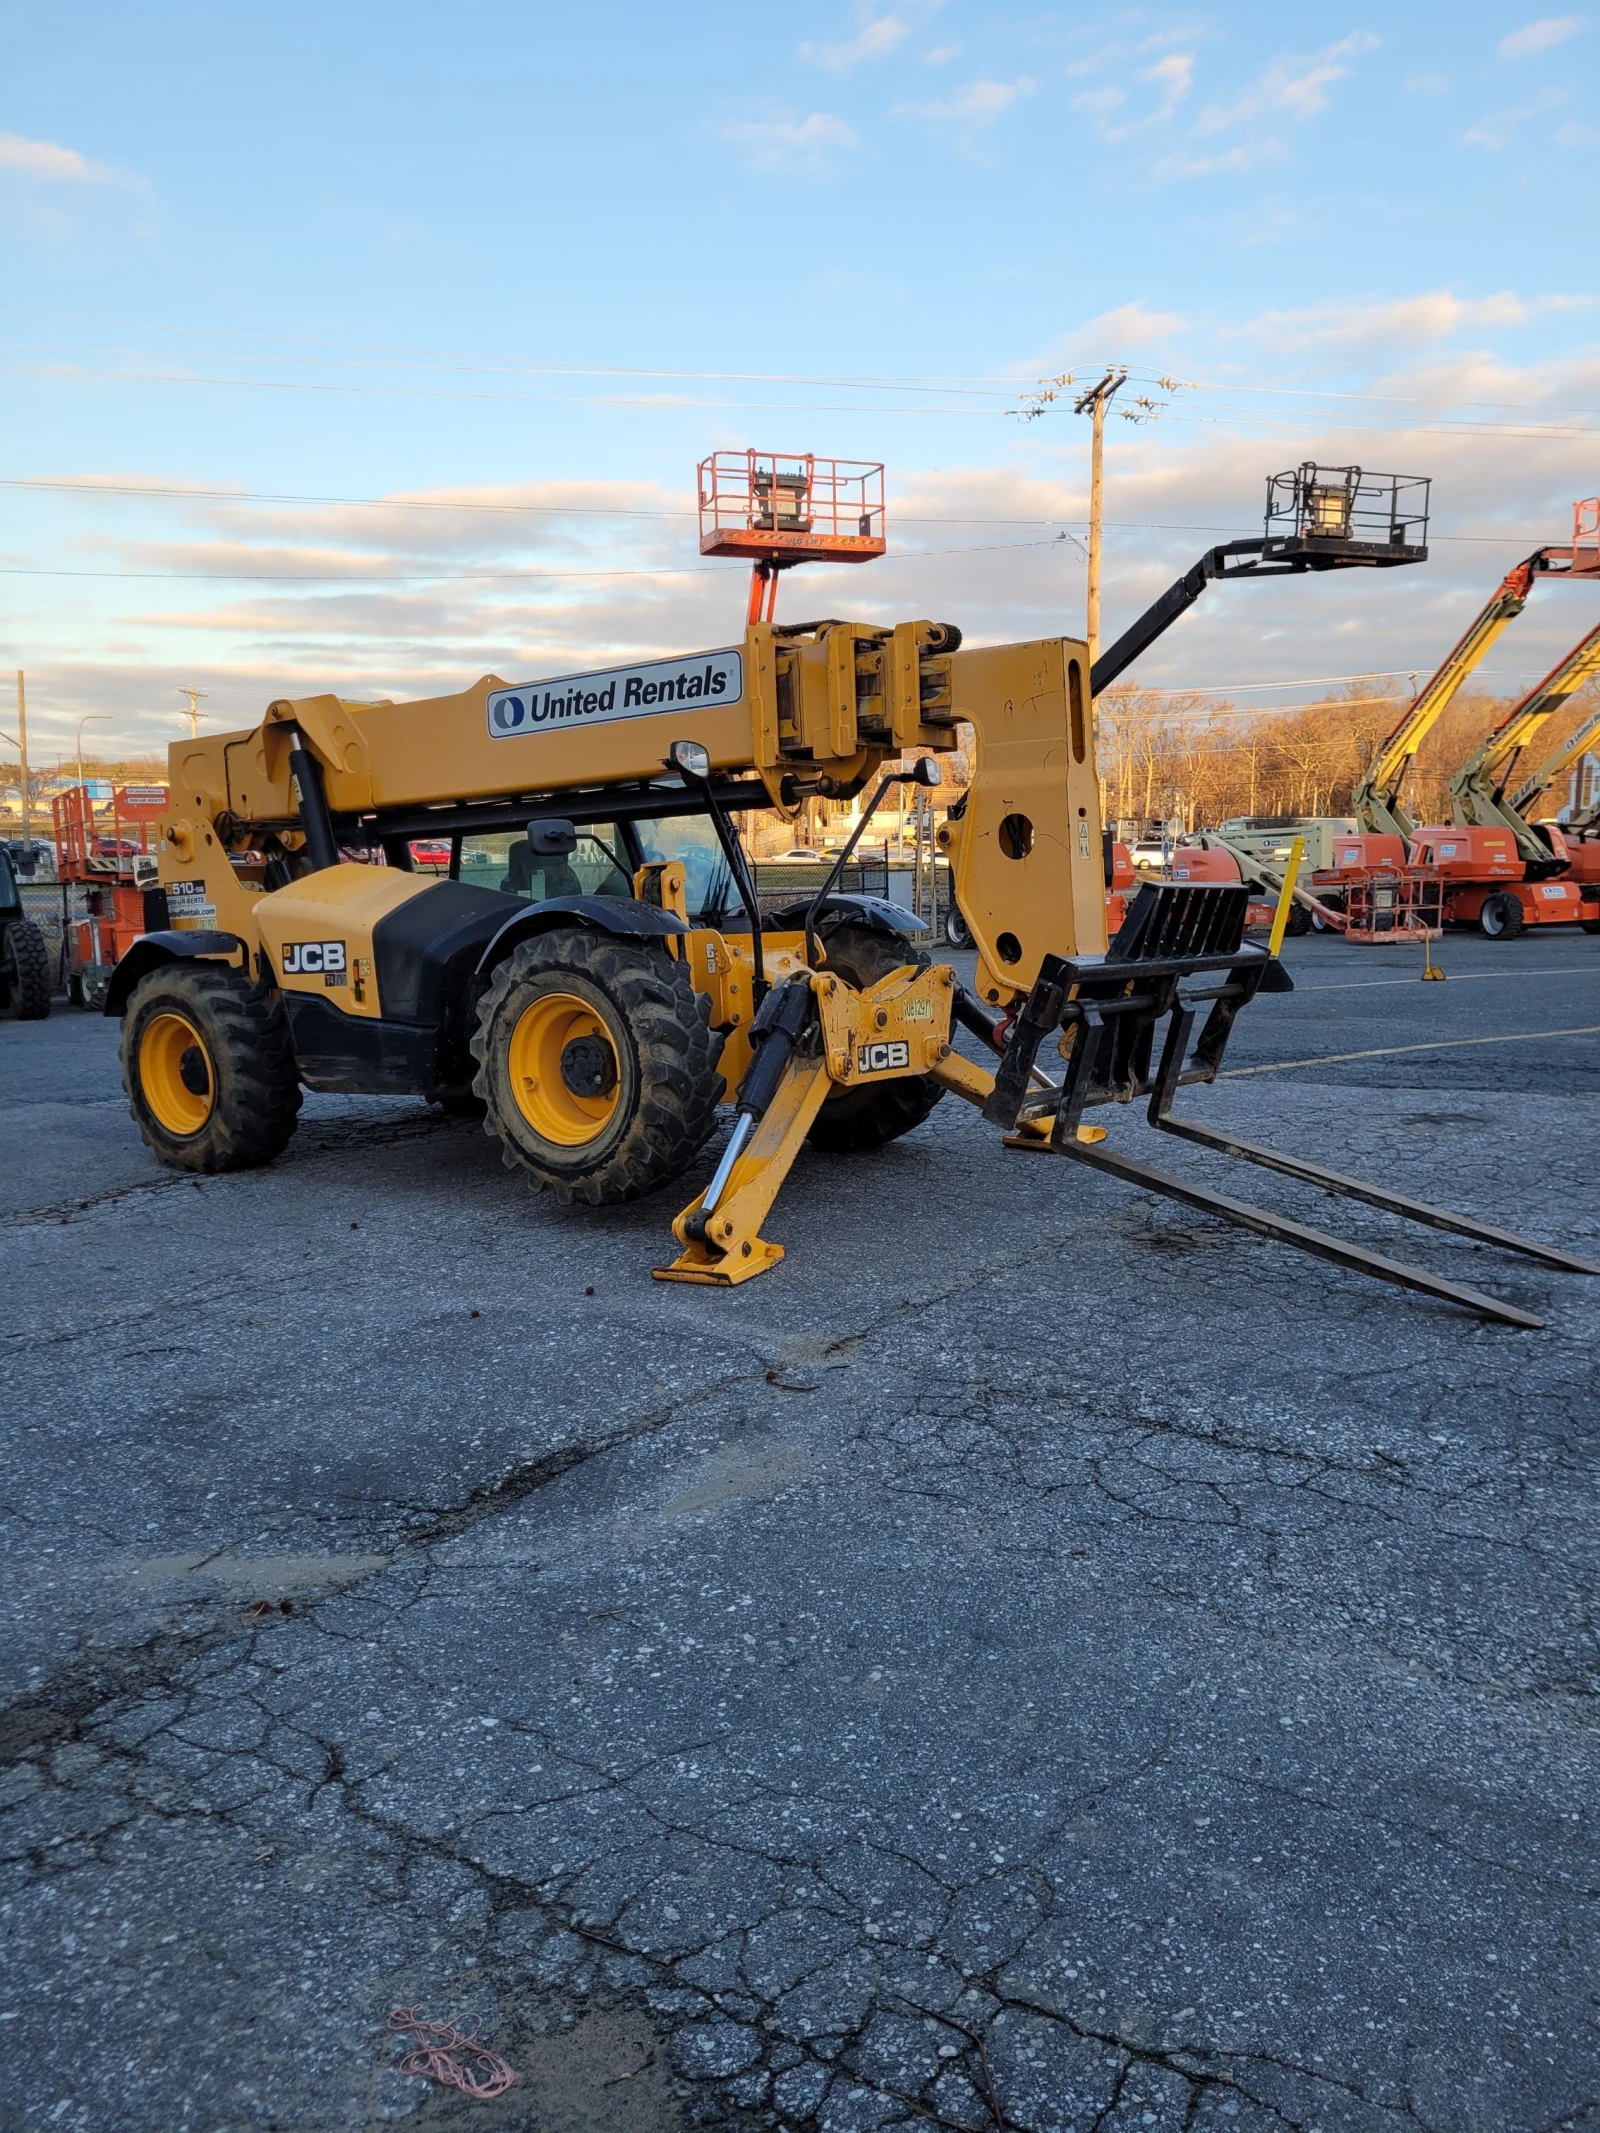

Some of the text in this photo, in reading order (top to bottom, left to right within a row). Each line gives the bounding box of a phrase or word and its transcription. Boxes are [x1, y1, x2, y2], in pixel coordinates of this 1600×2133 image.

[530, 664, 728, 722] United Rentals
[283, 943, 346, 972] JCB
[859, 1042, 909, 1072] JCB
